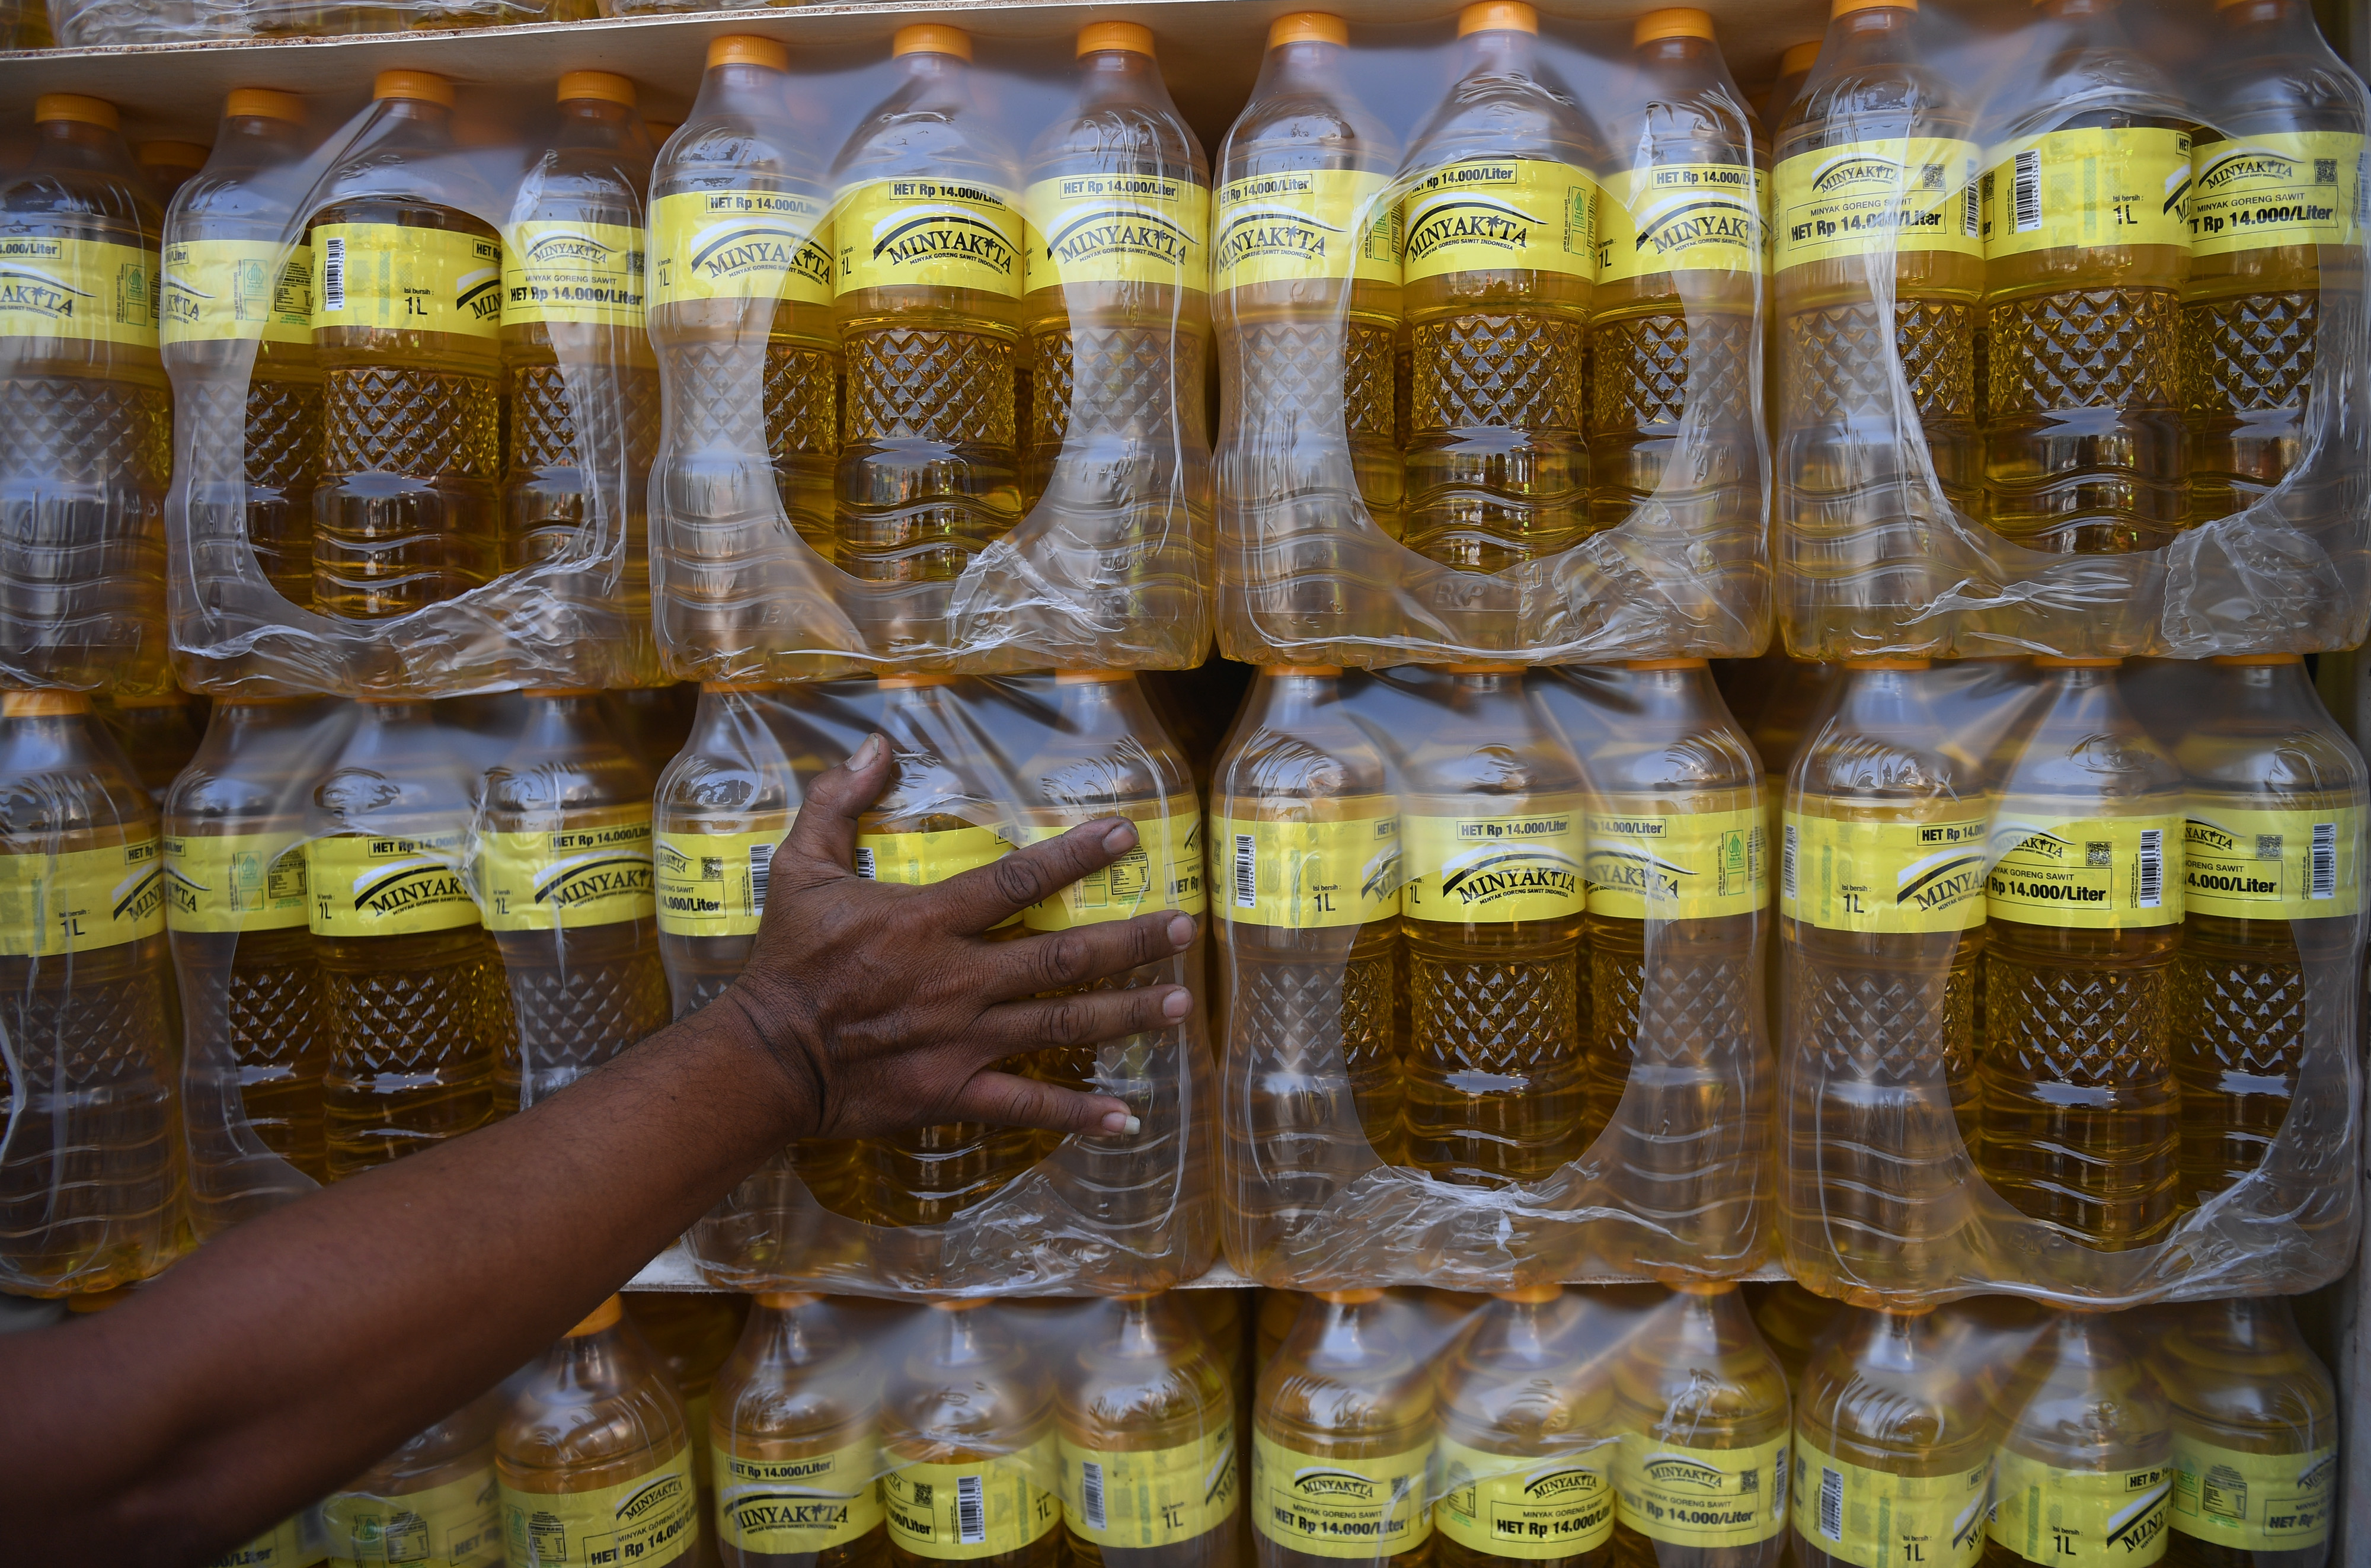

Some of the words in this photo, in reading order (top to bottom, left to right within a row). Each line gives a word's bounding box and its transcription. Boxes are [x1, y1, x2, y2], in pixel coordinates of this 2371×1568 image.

[1427, 177, 1439, 188] Rp
[1442, 168, 1513, 183] 14.000/Liter
[1657, 171, 1679, 184] HET
[1683, 171, 1698, 184] Rp
[2206, 160, 2293, 190] MINYAKITA
[894, 184, 916, 196] HET
[919, 184, 936, 197] Rp
[1063, 181, 1084, 194] HET
[1088, 181, 1103, 194] Rp
[1107, 181, 1176, 197] 14.000/Liter
[1231, 188, 1241, 201] Rp
[1244, 179, 1309, 196] 14.000/Liter
[711, 197, 732, 209] HET
[736, 197, 752, 210] Rp
[2197, 201, 2228, 213] MINYAK
[2231, 196, 2272, 207] GORENG
[2275, 193, 2305, 201] SAWIT
[2204, 216, 2223, 233] Rp
[2229, 206, 2333, 228] 14.000/Liter
[1791, 222, 1812, 242] HET
[1817, 219, 1836, 237] Rp
[1058, 225, 1186, 265] MINYAKITA
[1410, 215, 1527, 264] MINYAKITA
[1675, 241, 1697, 252] MINYAK
[533, 243, 607, 263] MINYAKITA
[887, 231, 1011, 275] MINYAKITA
[1079, 250, 1101, 263] MINYAK
[1147, 250, 1176, 266] INDONESIA
[1421, 245, 1438, 260] MINYAK
[1439, 239, 1459, 249] GORENG
[1481, 239, 1513, 251] INDONESIA
[705, 243, 830, 285] MINYAKITA
[910, 254, 932, 265] MINYAK
[978, 258, 1003, 275] INDONESIA
[1599, 249, 1612, 269] 1L
[592, 276, 616, 284] SAWIT
[728, 267, 752, 277] MINYAK
[510, 287, 527, 302] HET
[531, 286, 548, 302] Rp
[552, 287, 643, 306] 14.000/Liter
[1378, 824, 1390, 836] HET
[1461, 825, 1483, 836] HET
[1487, 824, 1503, 837] Rp
[1506, 821, 1567, 835] 14.000/Liter
[1922, 828, 1944, 841] HET
[1947, 828, 1960, 841] Rp
[373, 842, 394, 853] HET
[579, 834, 593, 846] Rp
[128, 848, 143, 860] HET
[2010, 869, 2043, 879] GORENG
[2046, 872, 2074, 881] SAWIT
[2216, 864, 2244, 873] SAWIT
[1480, 894, 1502, 905] MINYAK
[1503, 888, 1526, 897] GORENG
[1545, 889, 1568, 898] INDONESIA
[1992, 877, 2006, 895] Rp
[2009, 881, 2106, 901] 14.000/Liter
[1938, 898, 1957, 911] MINYAK
[748, 1466, 760, 1479] Rp
[765, 1461, 830, 1477] 14.000/Liter
[2130, 1474, 2148, 1488] HET
[2150, 1471, 2159, 1483] Rp
[1670, 1497, 1705, 1508] GORENG
[1275, 1506, 1295, 1526] HET
[1299, 1516, 1316, 1534] Rp
[1293, 1504, 1321, 1516] MINYAK
[1322, 1511, 1356, 1519] GORENG
[1359, 1511, 1382, 1519] SAWIT
[1555, 1506, 1586, 1517] GORENG
[1646, 1500, 1663, 1519] Rp
[1669, 1508, 1754, 1525] 14.000/Liter
[617, 1528, 647, 1543] MINYAK
[648, 1513, 676, 1531] GORENG
[1497, 1519, 1524, 1535] HET
[1529, 1522, 1548, 1538] Rp
[2061, 1527, 2080, 1535] bersih
[2270, 1516, 2297, 1529] HET
[591, 1547, 620, 1565] HET
[625, 1542, 644, 1558] Rp
